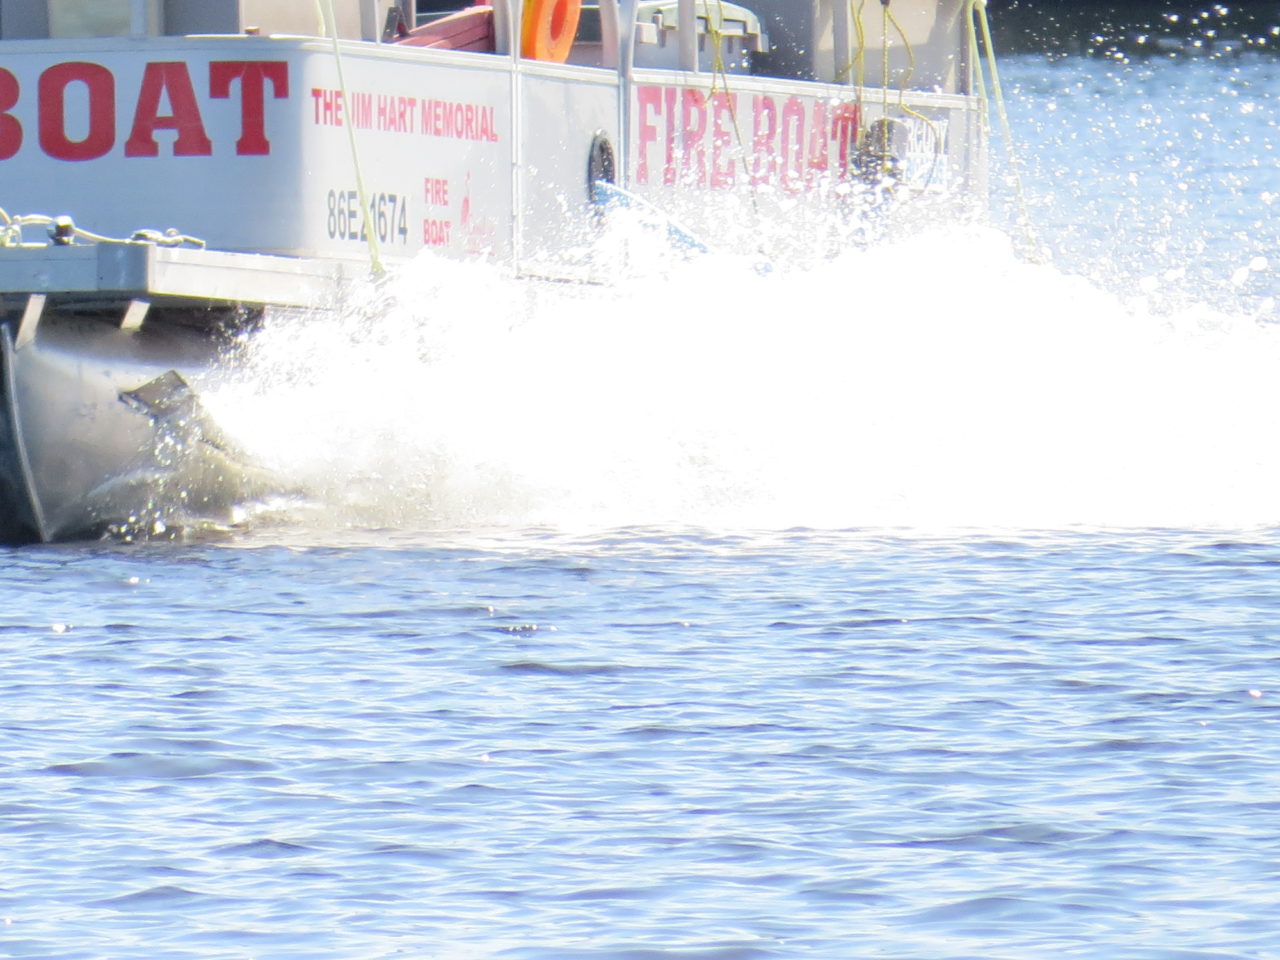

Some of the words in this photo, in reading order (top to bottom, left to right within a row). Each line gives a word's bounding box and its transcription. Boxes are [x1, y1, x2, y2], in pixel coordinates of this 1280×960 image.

[311, 88, 343, 126] THE
[376, 94, 417, 134] HART
[420, 98, 499, 143] MEMORIAL
[635, 85, 738, 188] FIRE
[750, 95, 858, 194] BOAT
[424, 177, 449, 206] FIRE
[423, 218, 452, 247] BOAT
